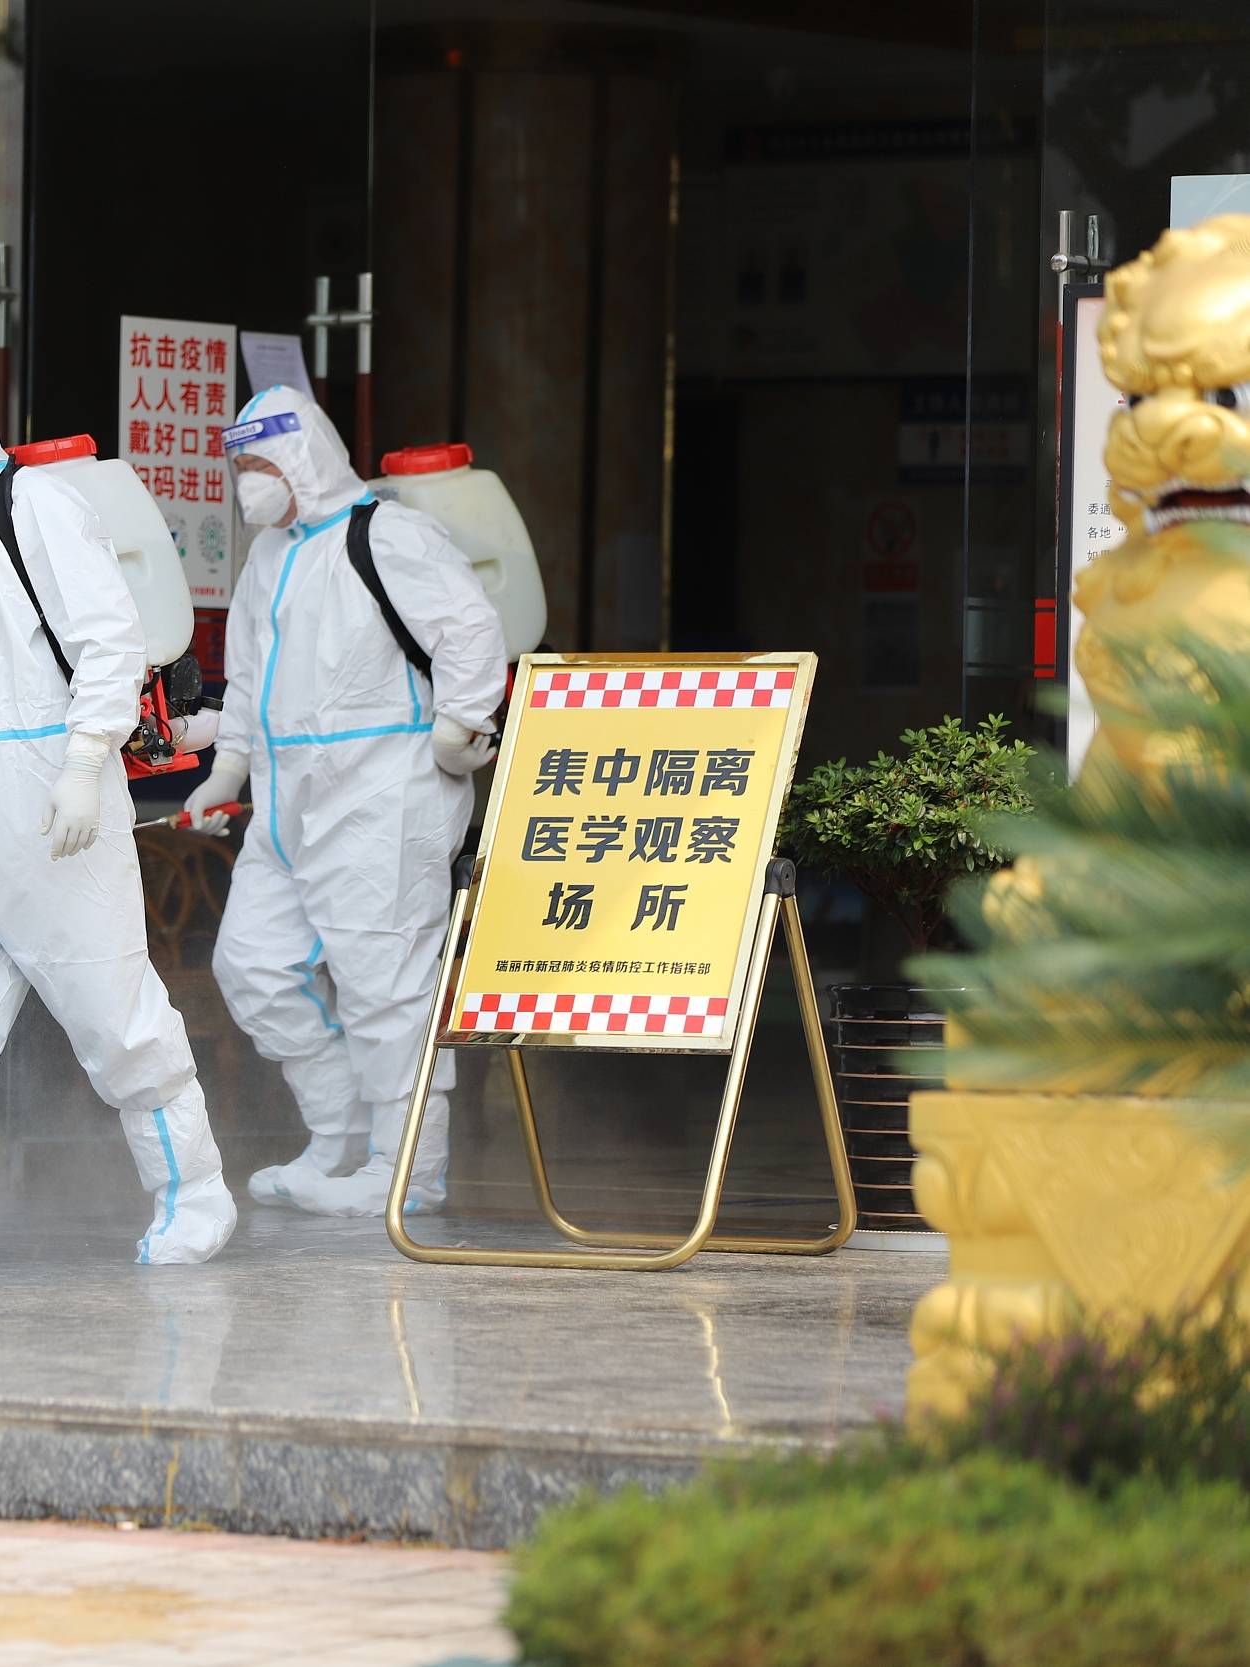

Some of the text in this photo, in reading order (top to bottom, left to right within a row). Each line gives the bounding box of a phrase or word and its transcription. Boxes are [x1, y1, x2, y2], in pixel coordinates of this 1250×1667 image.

[130, 332, 226, 374] 抗击疫情
[130, 376, 226, 416] 人人有责
[130, 420, 225, 458] 戴好口罩
[533, 748, 755, 796] 集中隔离
[520, 815, 740, 864] 医学观察
[495, 960, 711, 976] 瑞丽市新冠肺炎疫情防控工作指挥部
